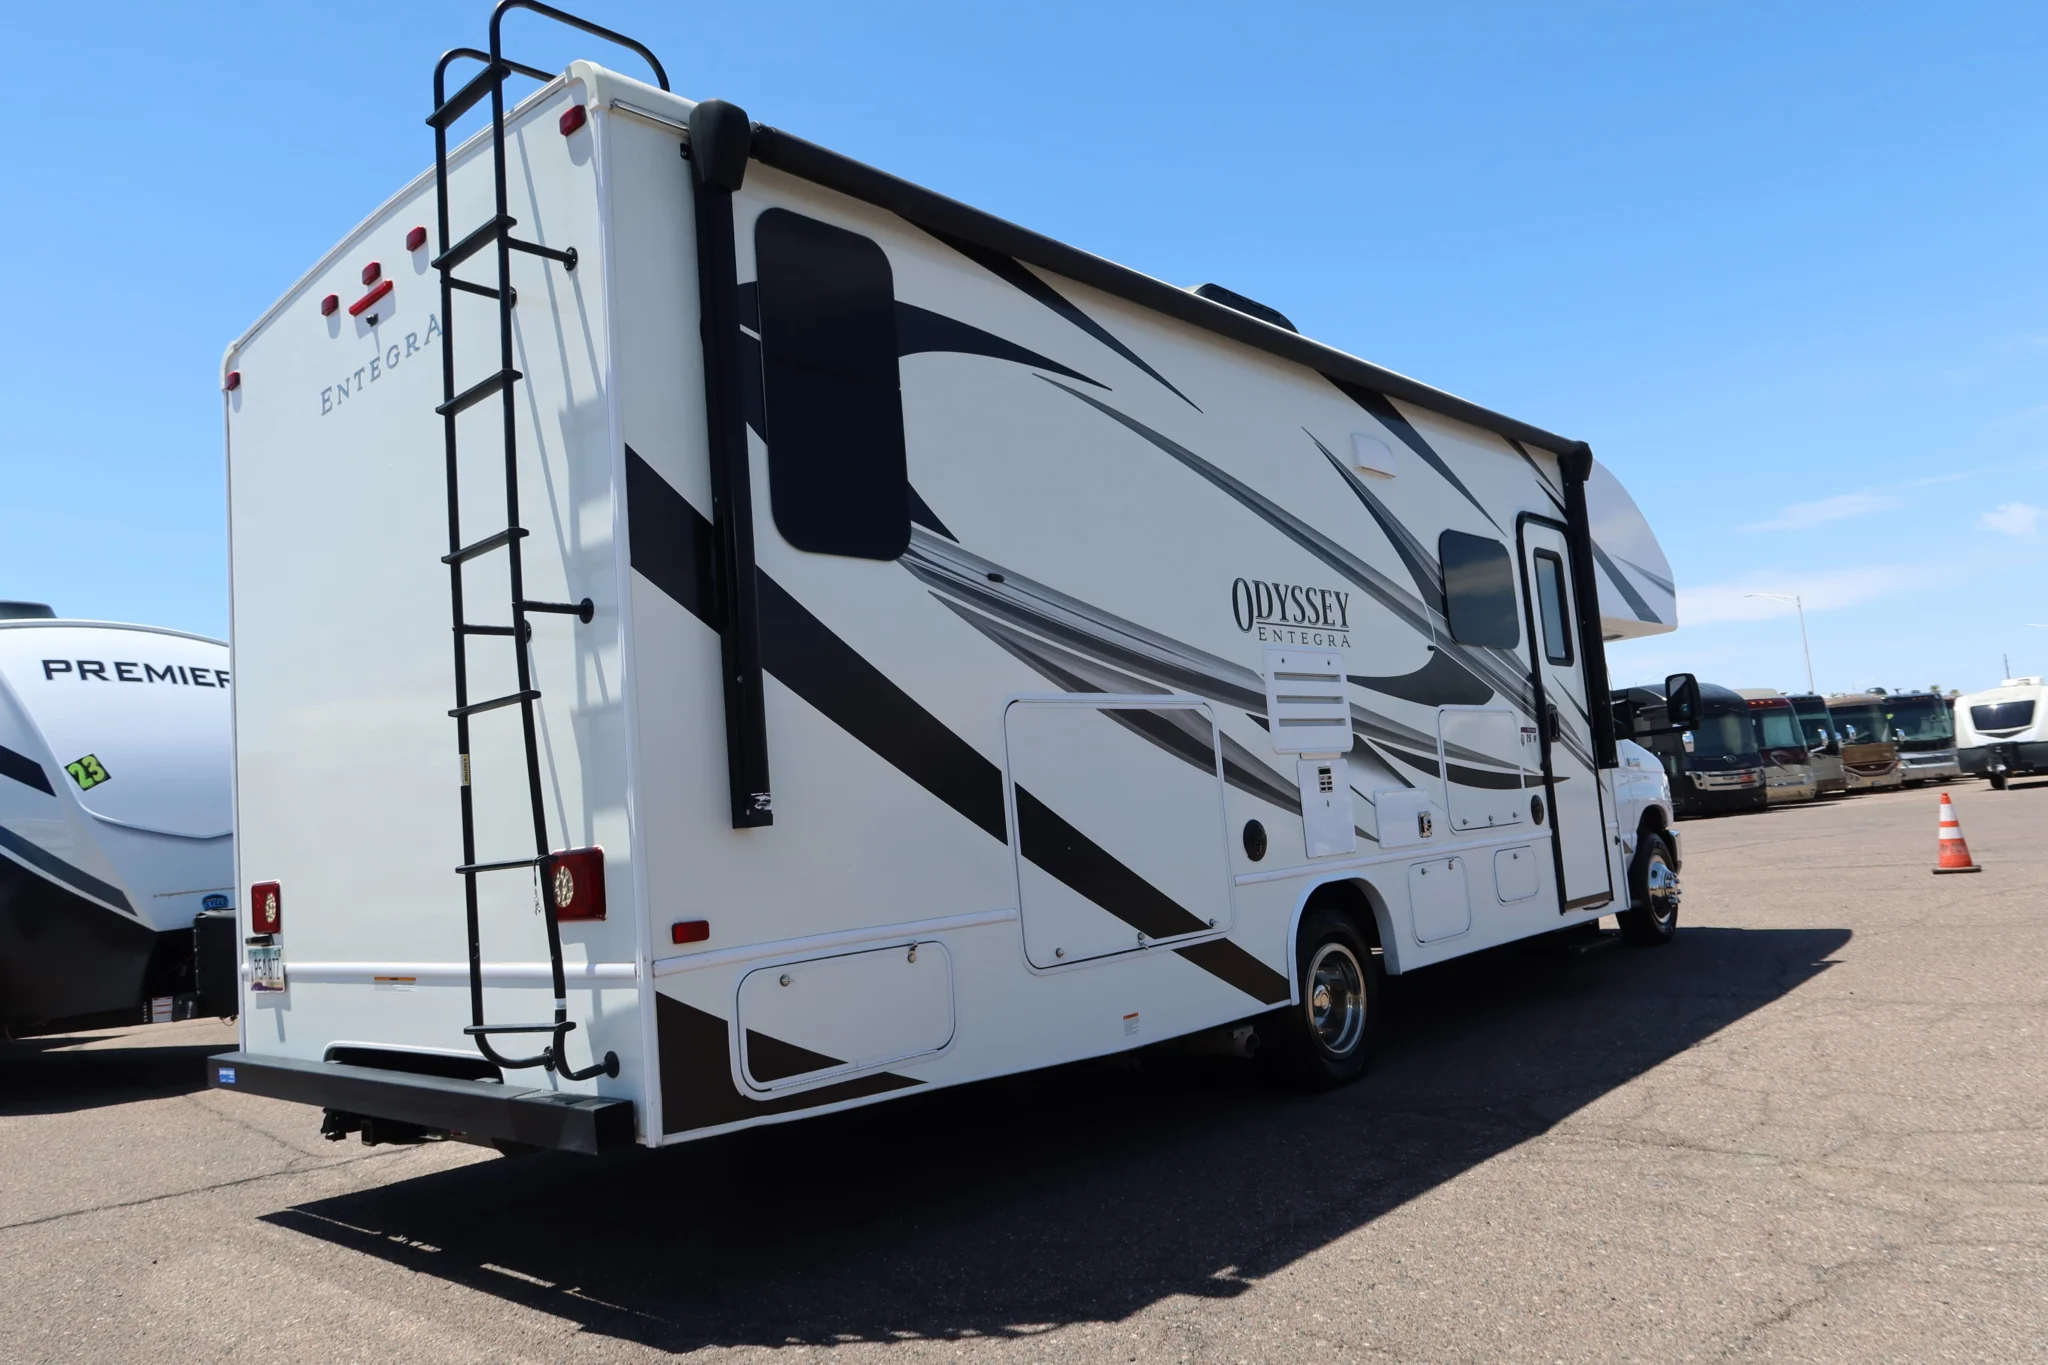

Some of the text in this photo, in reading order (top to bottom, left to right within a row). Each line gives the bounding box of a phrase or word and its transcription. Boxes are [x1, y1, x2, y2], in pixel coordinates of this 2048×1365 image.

[320, 313, 443, 416] ENTEGRA
[1231, 577, 1350, 633] ODYSSEY
[1257, 626, 1351, 648] ENTEGRA
[67, 755, 107, 789] 23
